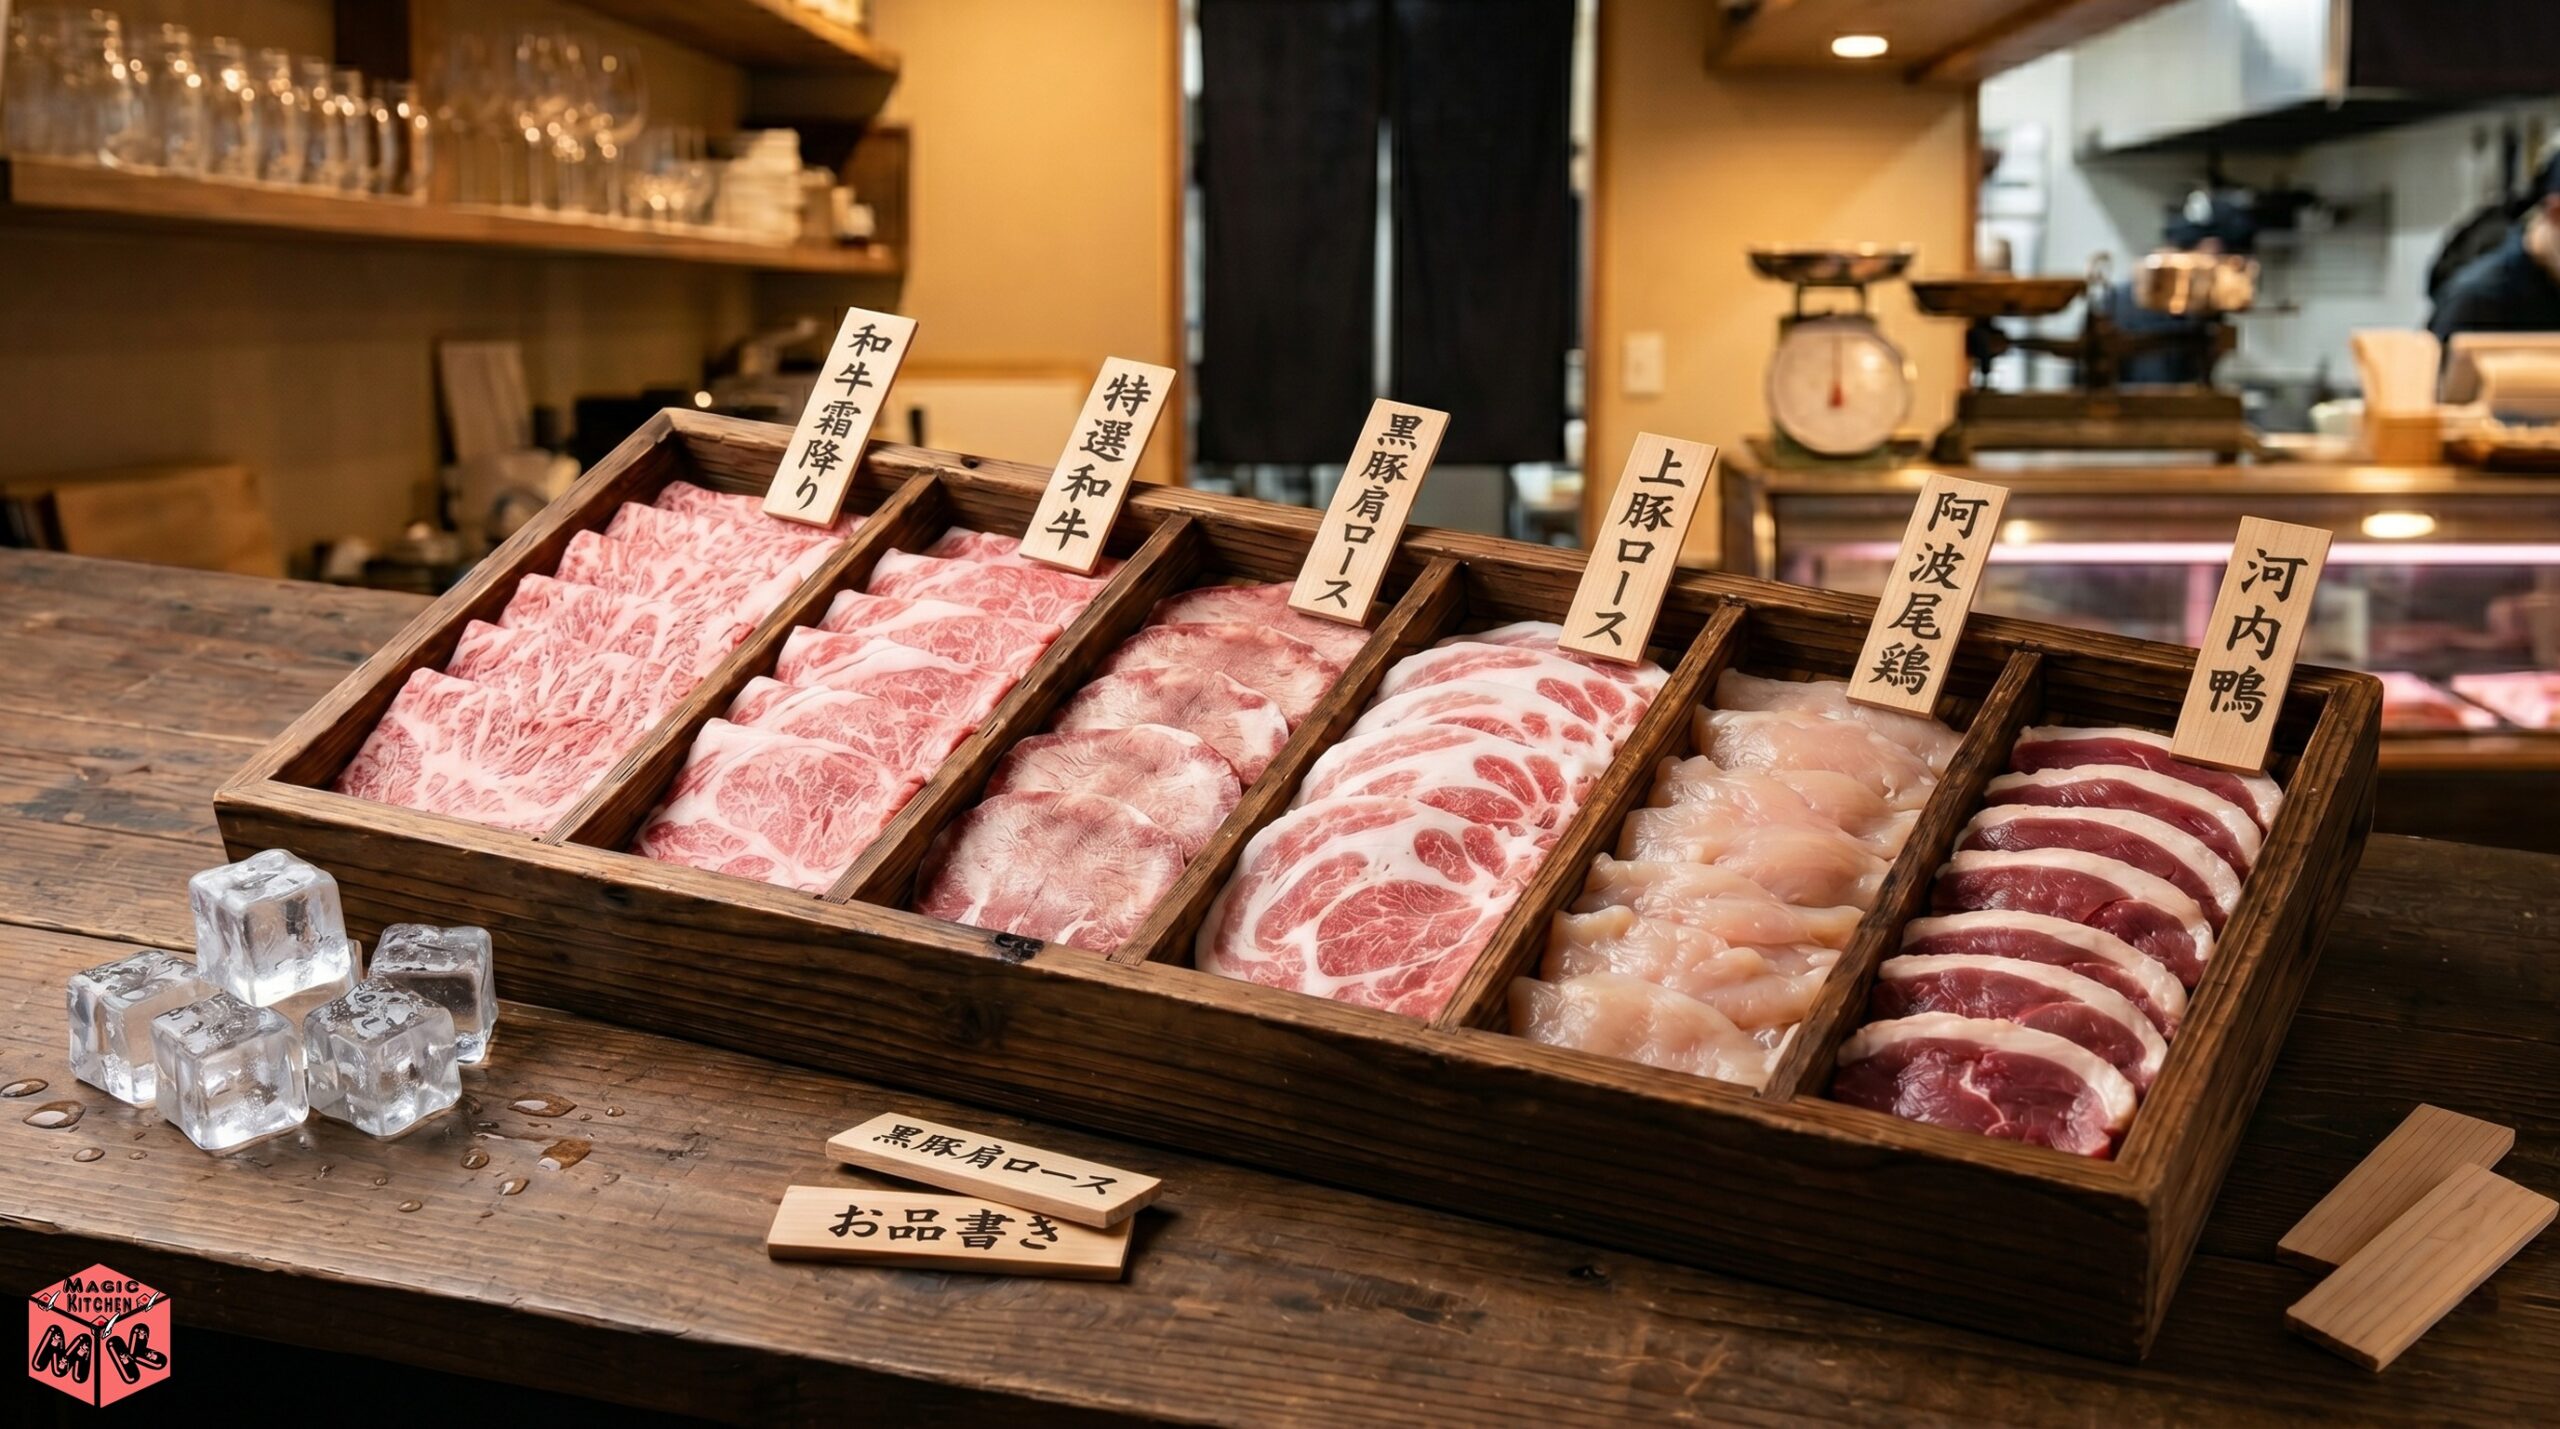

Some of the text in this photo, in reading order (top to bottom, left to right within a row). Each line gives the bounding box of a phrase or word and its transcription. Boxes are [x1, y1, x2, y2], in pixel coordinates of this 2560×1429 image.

[798, 323, 893, 510] 和牛霜降り
[1045, 373, 1152, 551] 特選和牛
[1314, 413, 1423, 608] 黒豚肩ロース
[1582, 448, 1686, 646] 上豚ロース
[1869, 492, 1989, 696] 阿波尾鶏
[2209, 548, 2309, 723] 河内鴨
[828, 1204, 1059, 1250] お品書き
[872, 1124, 1118, 1195] 黒豚肩ロース
